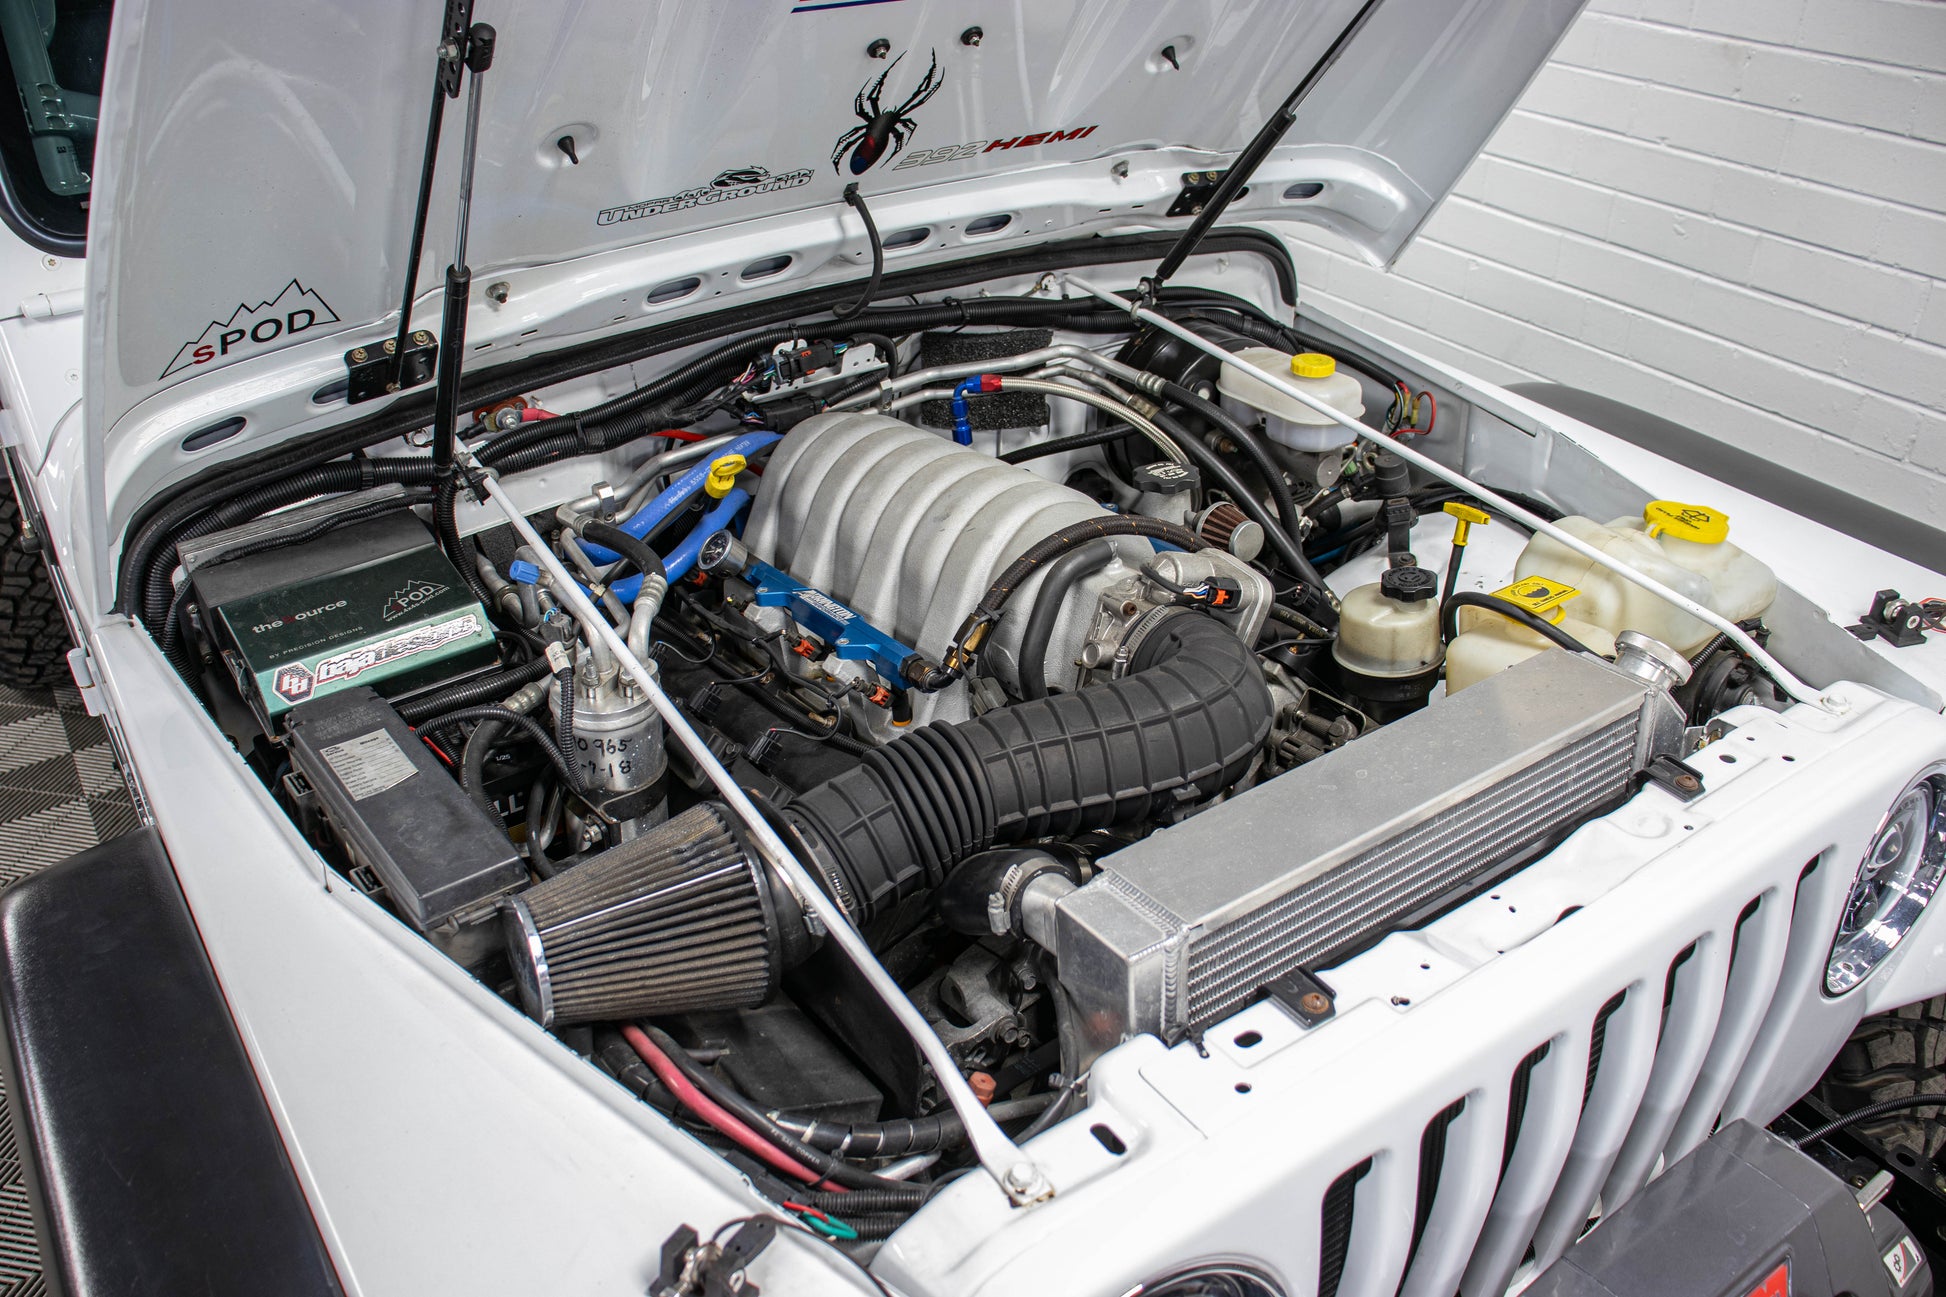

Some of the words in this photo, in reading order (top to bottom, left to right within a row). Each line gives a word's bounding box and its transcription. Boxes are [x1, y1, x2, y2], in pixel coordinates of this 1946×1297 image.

[892, 140, 989, 171] 392
[982, 125, 1099, 153] HEMI
[282, 638, 327, 656] PRECISION
[328, 626, 364, 640] DESIGNS
